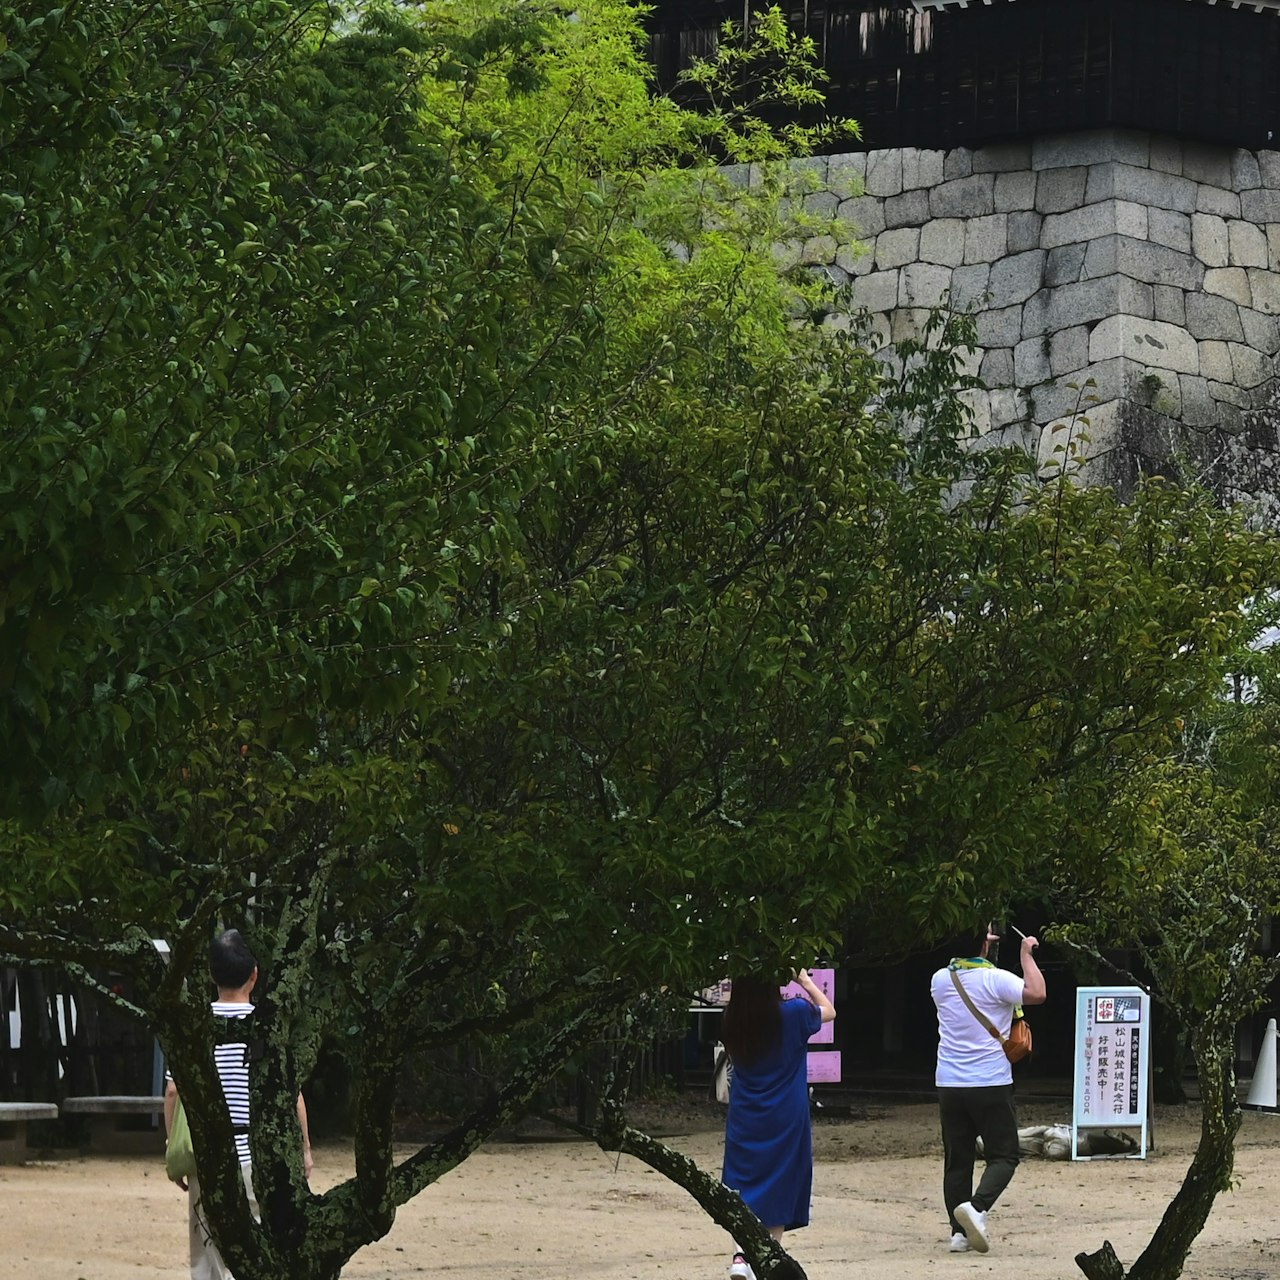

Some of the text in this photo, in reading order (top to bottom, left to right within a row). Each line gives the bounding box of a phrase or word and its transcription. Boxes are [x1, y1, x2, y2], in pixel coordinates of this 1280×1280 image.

[1113, 1027, 1126, 1114] 松山城登城記念符
